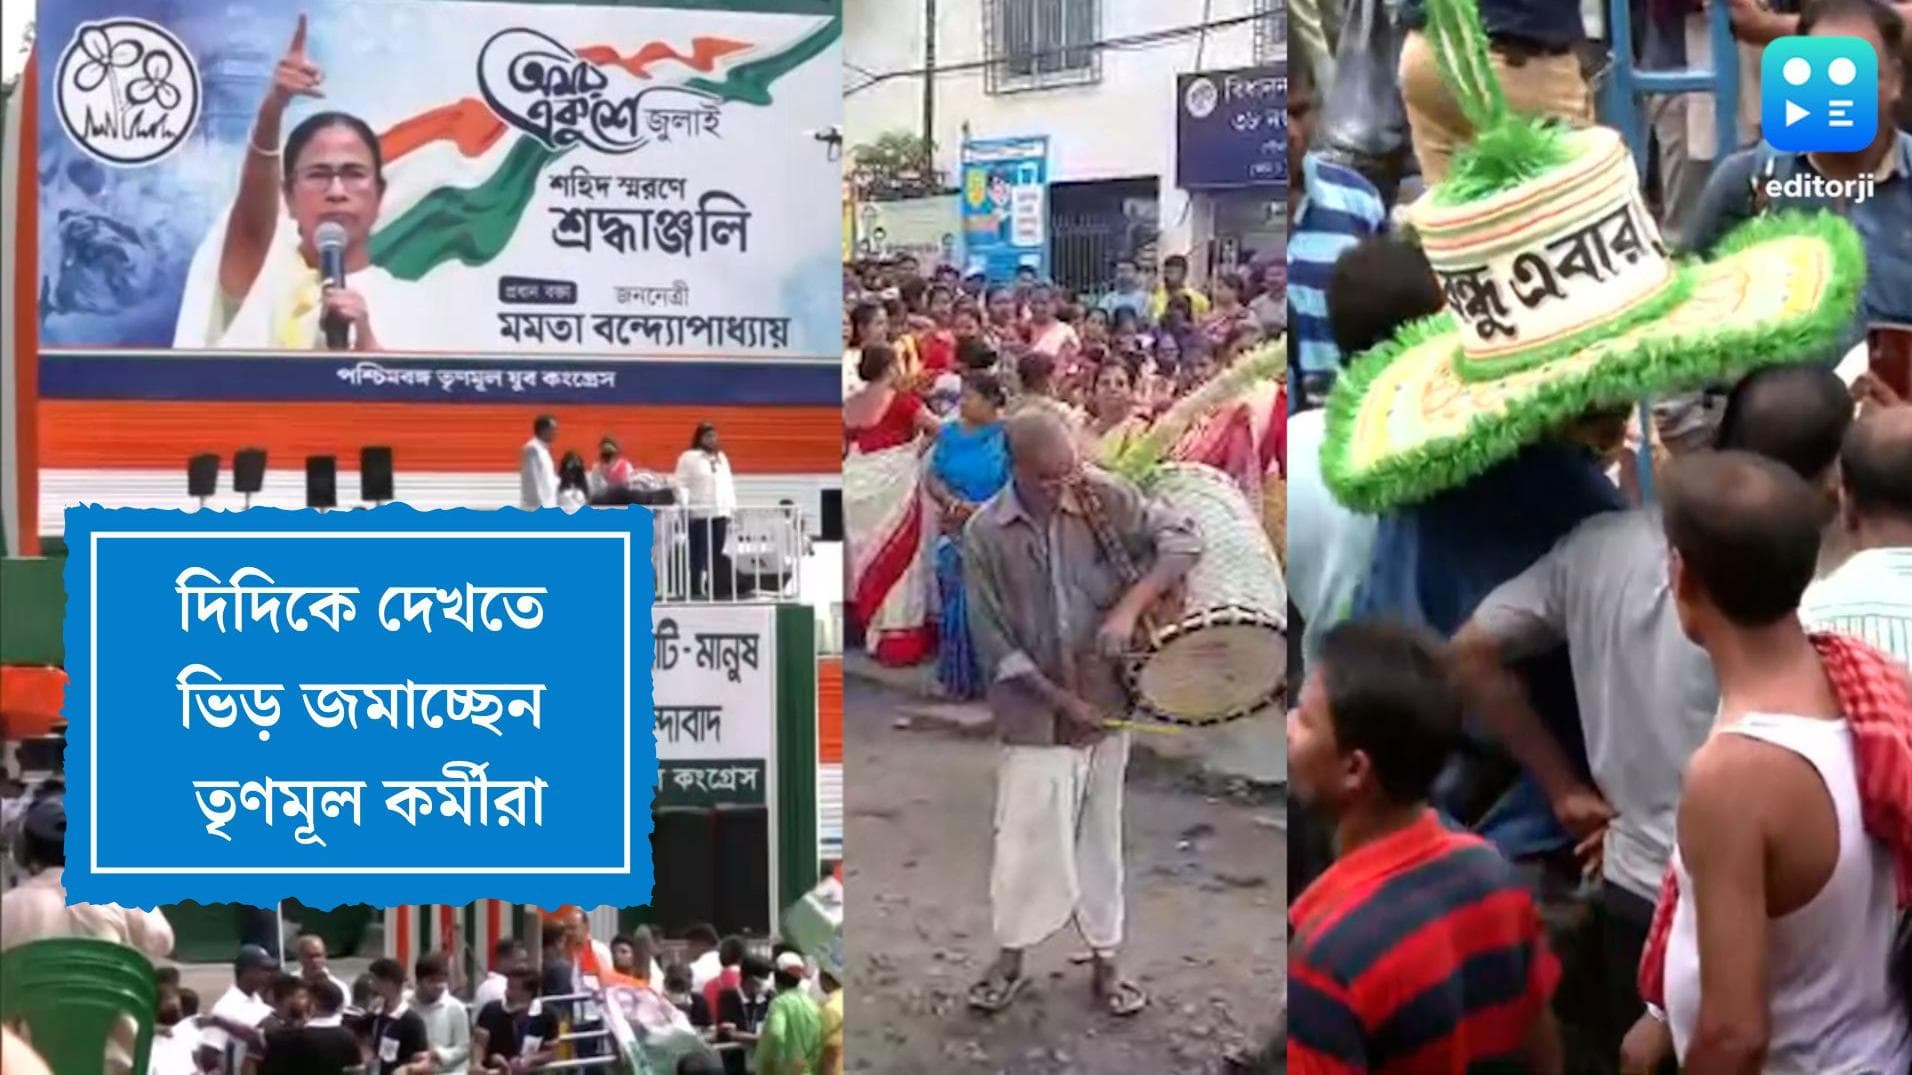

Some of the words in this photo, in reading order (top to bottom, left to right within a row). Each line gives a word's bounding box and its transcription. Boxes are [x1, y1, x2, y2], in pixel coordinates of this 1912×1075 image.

[643, 101, 722, 141] জুলাই
[549, 166, 613, 199] শহিদ
[616, 176, 688, 200] স্মরণে
[548, 190, 752, 257] শ্রদ্ধাঞ্জলি
[1509, 203, 1650, 309] এবার
[613, 280, 689, 307] জননেত্রী
[497, 312, 586, 344] মমতা
[591, 314, 791, 348] বন্দ্যোপাধ্যায়
[336, 362, 433, 387] পশ্চিমবঙ্গ
[436, 369, 502, 392] তৃণমূল
[507, 370, 537, 392] যুব
[541, 371, 617, 389] কংগ্রেস
[672, 766, 760, 793] কংগ্রেস
